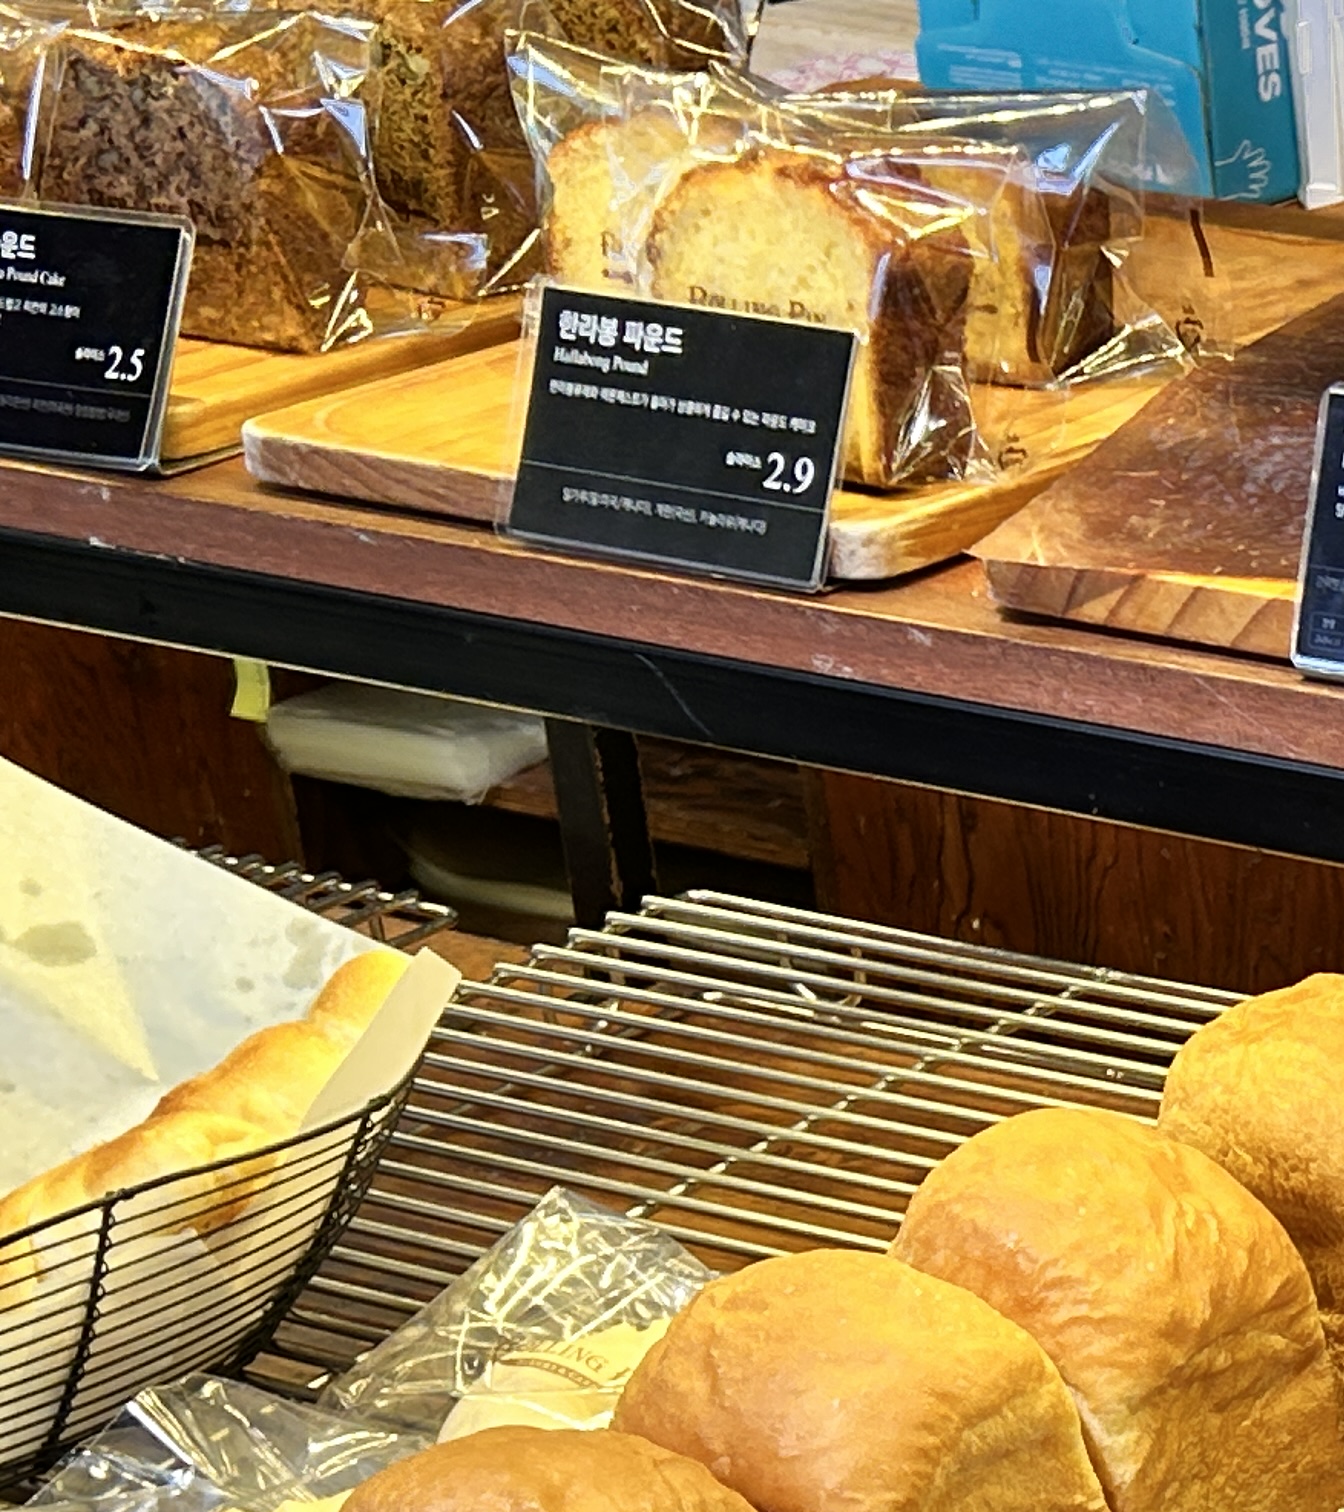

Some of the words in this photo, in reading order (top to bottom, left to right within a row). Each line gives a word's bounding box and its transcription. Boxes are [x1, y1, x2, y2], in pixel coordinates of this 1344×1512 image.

[1253, 0, 1282, 102] VES
[0, 230, 36, 260] 운드
[559, 310, 618, 347] 한라봉
[622, 321, 683, 354] 파운드
[104, 345, 145, 381] 2.5
[762, 452, 815, 493] 2.9
